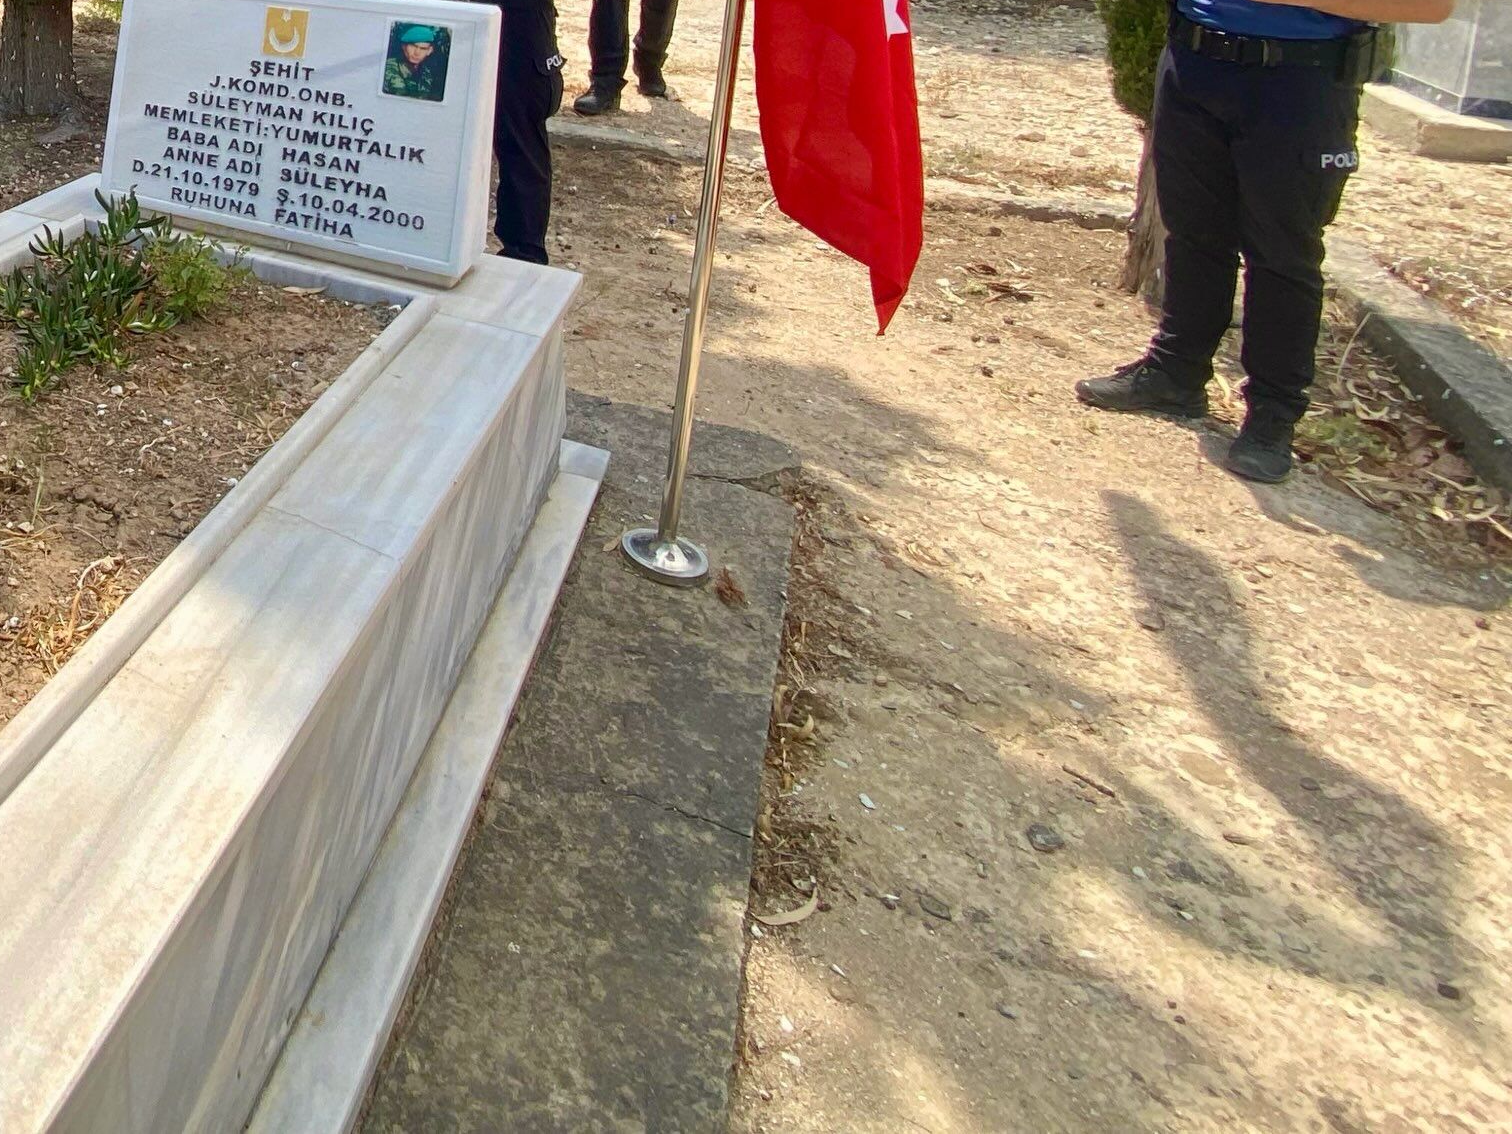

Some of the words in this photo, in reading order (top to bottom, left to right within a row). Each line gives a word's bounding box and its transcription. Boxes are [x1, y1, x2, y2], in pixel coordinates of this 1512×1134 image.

[209, 75, 353, 109] J.KOMD.ONB.
[249, 59, 315, 81] ŞEHİT
[143, 103, 426, 164] MEMLEKETİ:YUMURTALIK
[187, 89, 304, 122] SÜLEYMAN
[312, 110, 375, 136] KILIÇ
[163, 146, 220, 168] ANNE
[226, 158, 261, 176] ADI
[280, 167, 388, 202] SÜLEYHA
[167, 126, 219, 148] BABA
[228, 138, 263, 157] ADI
[281, 147, 361, 174] HASAN
[132, 159, 260, 197] D.21.10.1979
[276, 188, 425, 231] Ş.10.04.2000
[171, 186, 257, 218] RUHUNA
[274, 208, 354, 239] FATİHA
